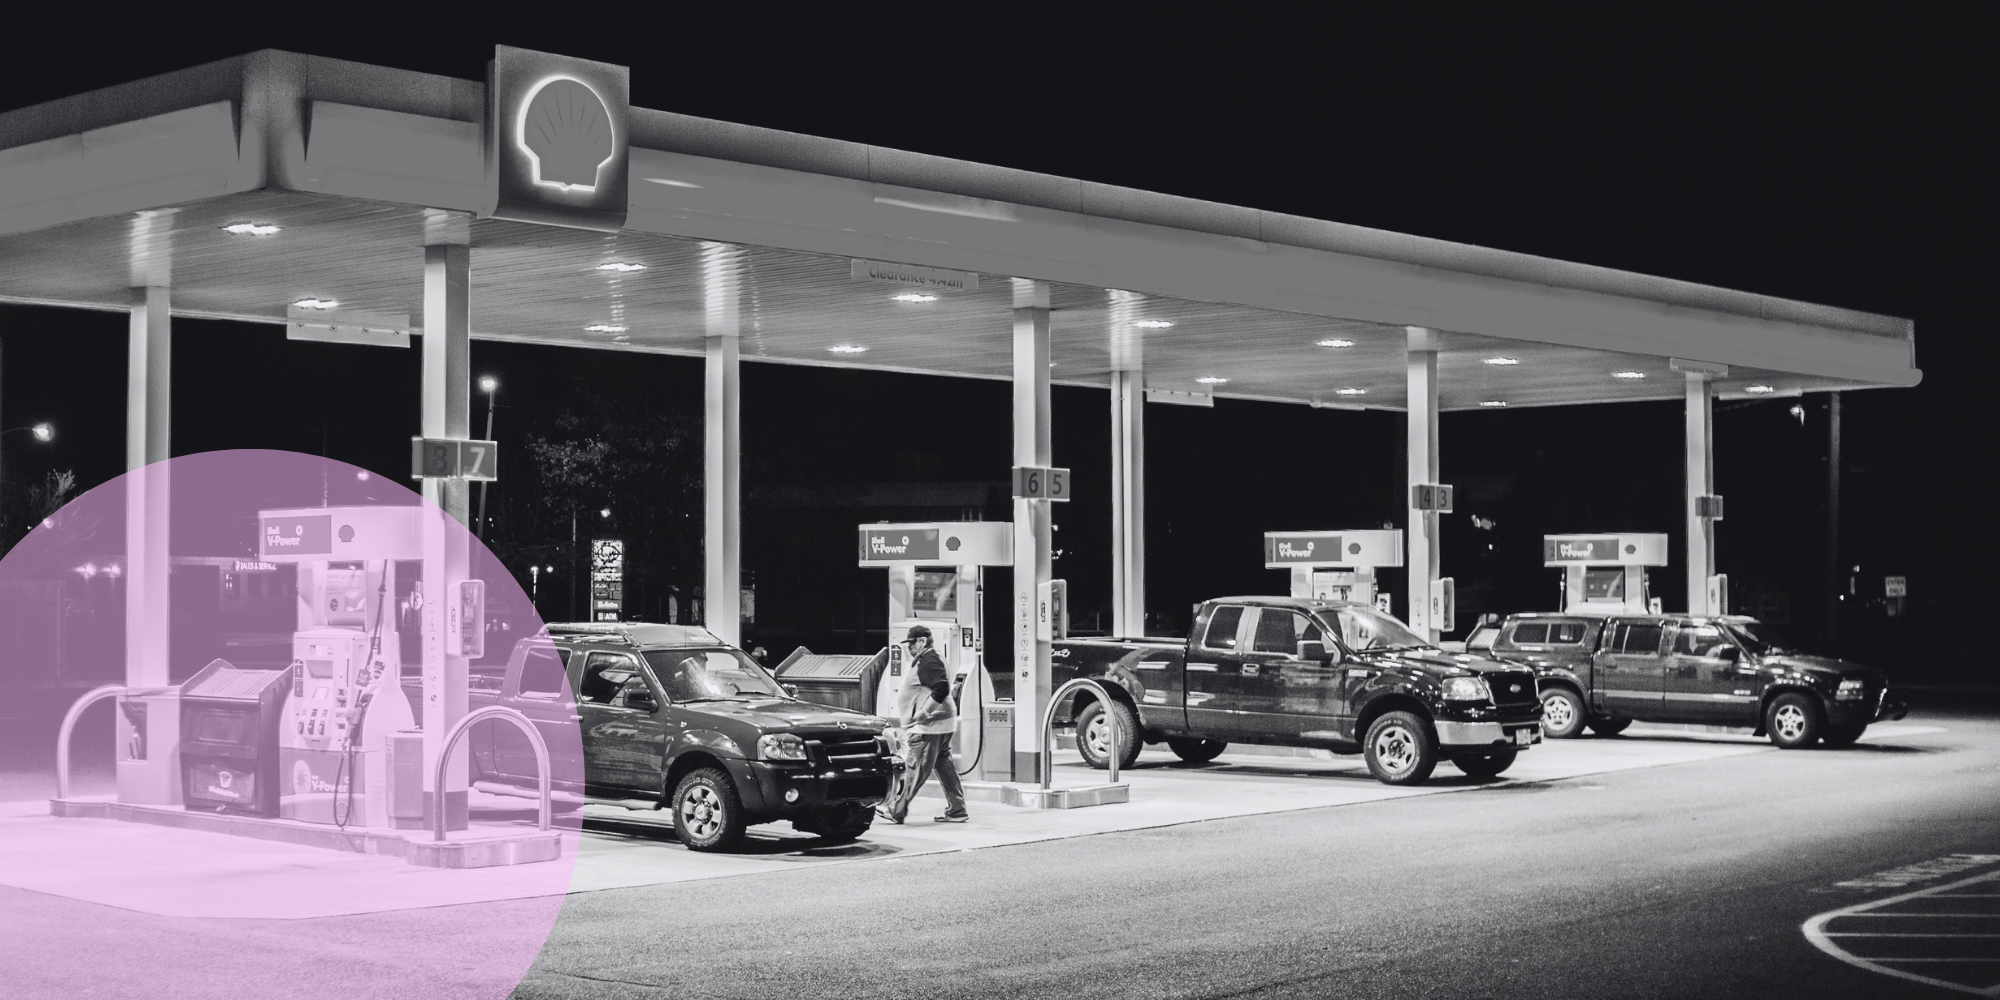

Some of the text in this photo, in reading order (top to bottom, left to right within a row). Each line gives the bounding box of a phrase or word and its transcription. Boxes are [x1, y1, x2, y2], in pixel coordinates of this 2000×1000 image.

[869, 267, 926, 284] Clearance
[433, 445, 448, 472] 8
[470, 446, 485, 473] 7
[1028, 471, 1039, 495] 6
[1052, 473, 1062, 496] 5
[1424, 488, 1431, 507] 4
[1440, 490, 1447, 507] 3
[266, 526, 280, 535] Shell
[267, 535, 300, 547] V-Power
[871, 536, 885, 545] Shell
[871, 544, 907, 554] V-Power
[1279, 549, 1312, 558] V-Power
